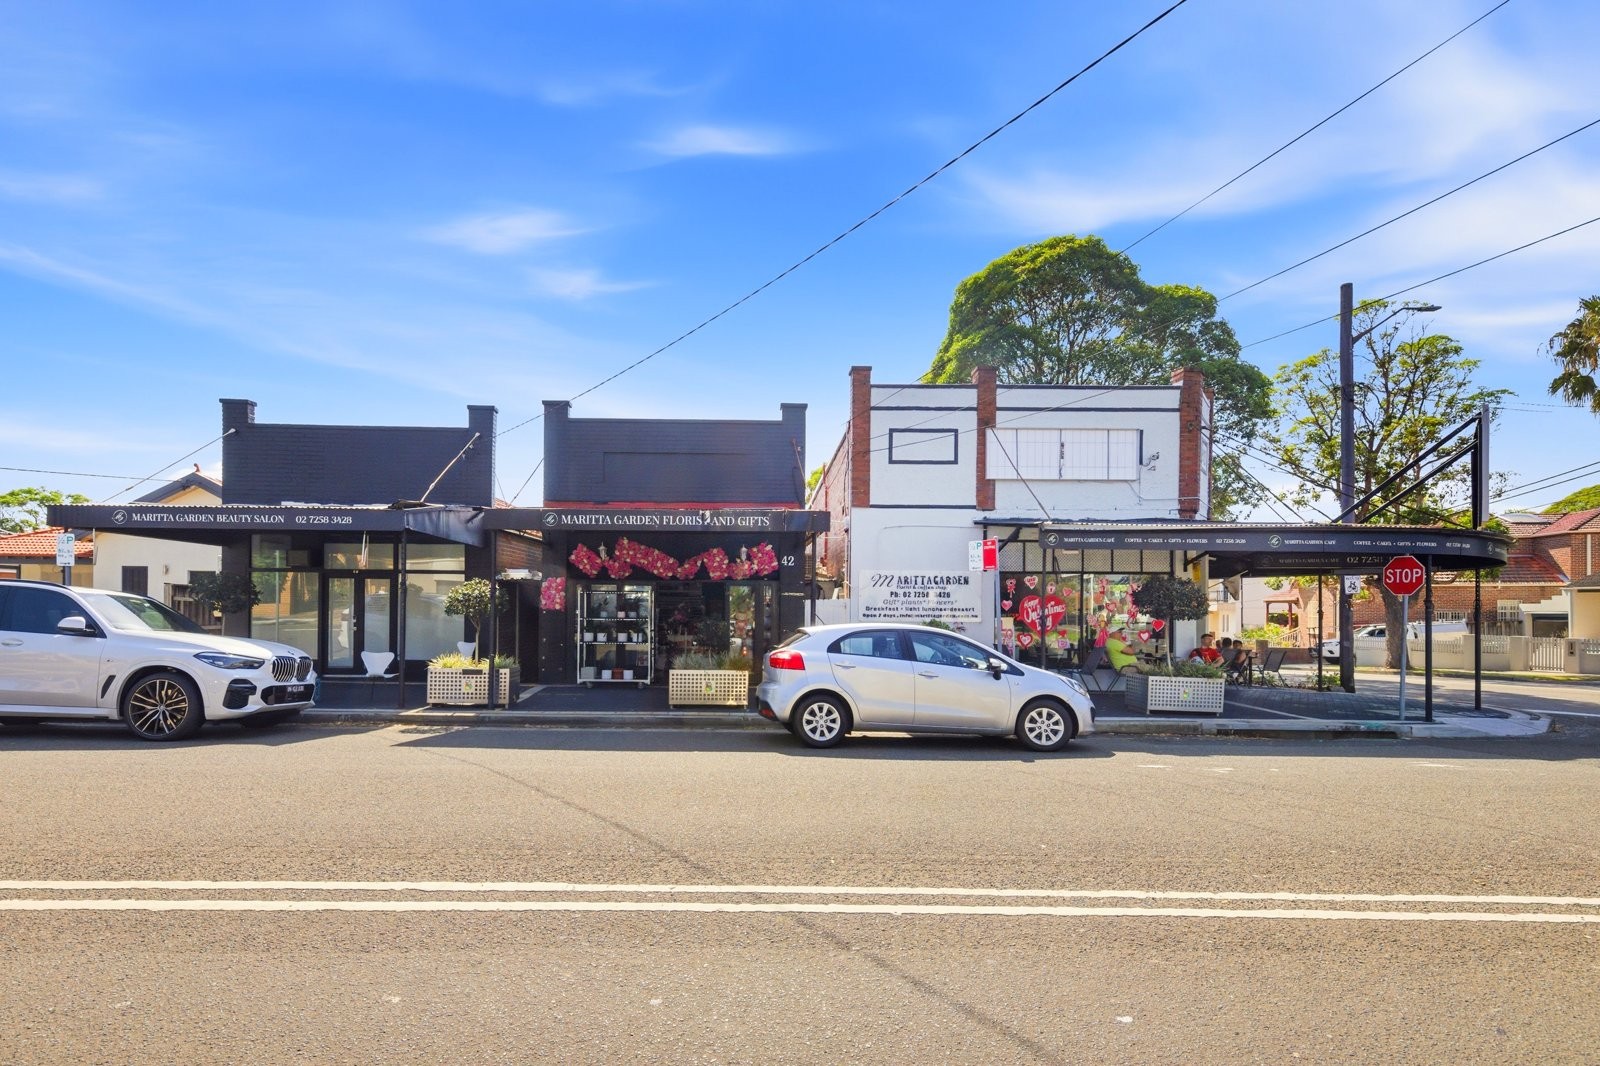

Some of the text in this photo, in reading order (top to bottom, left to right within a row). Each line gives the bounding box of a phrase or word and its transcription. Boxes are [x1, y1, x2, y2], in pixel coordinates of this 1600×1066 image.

[132, 513, 174, 522] MARITTA
[175, 513, 214, 522] GARDEN
[216, 514, 252, 523] BEAUTY
[253, 515, 285, 523] SALON
[309, 516, 329, 524] 7258
[561, 515, 770, 526] MARITTA GARDEN FLORIS AND GIFTS
[781, 555, 795, 566] 42
[1346, 556, 1361, 564] 02
[1386, 568, 1422, 583] STOP
